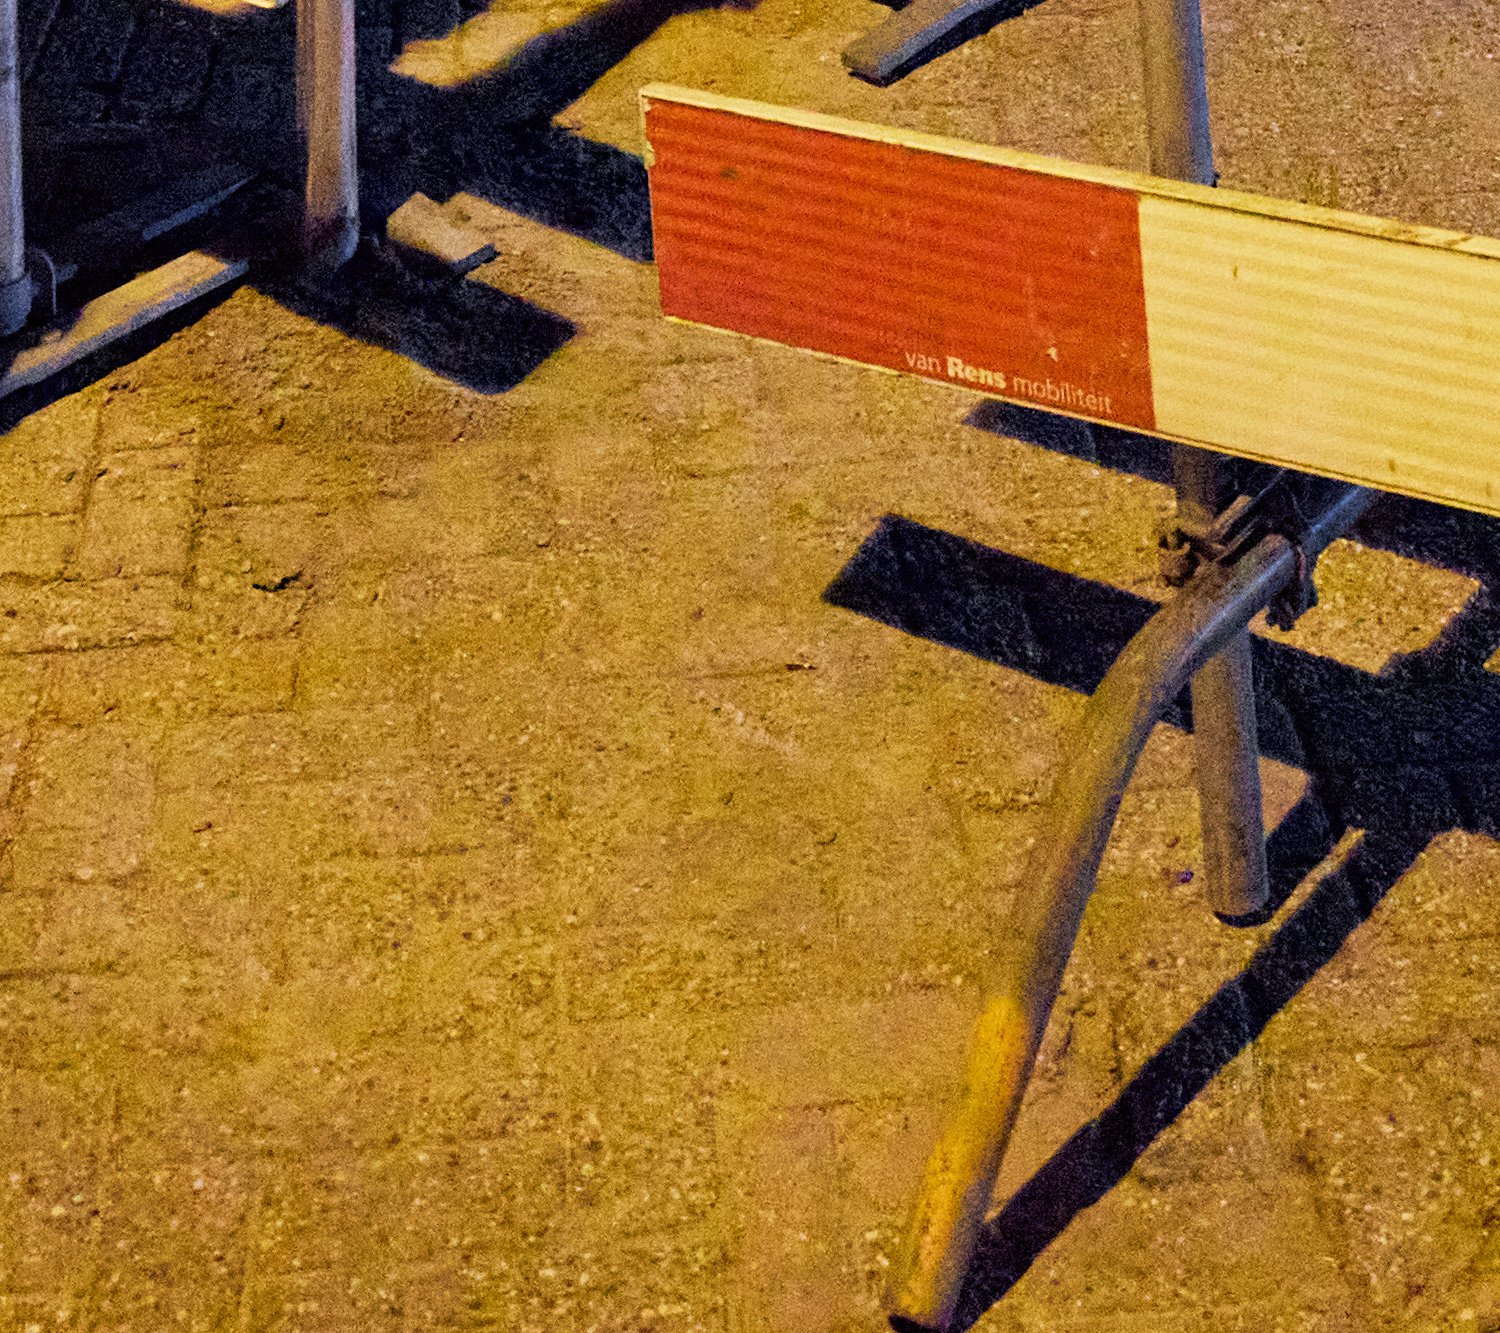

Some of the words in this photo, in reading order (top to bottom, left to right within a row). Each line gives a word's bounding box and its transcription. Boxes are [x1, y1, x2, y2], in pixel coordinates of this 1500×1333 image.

[905, 351, 942, 373] van
[946, 355, 1007, 390] Rens
[1013, 377, 1113, 414] mobiliteit
